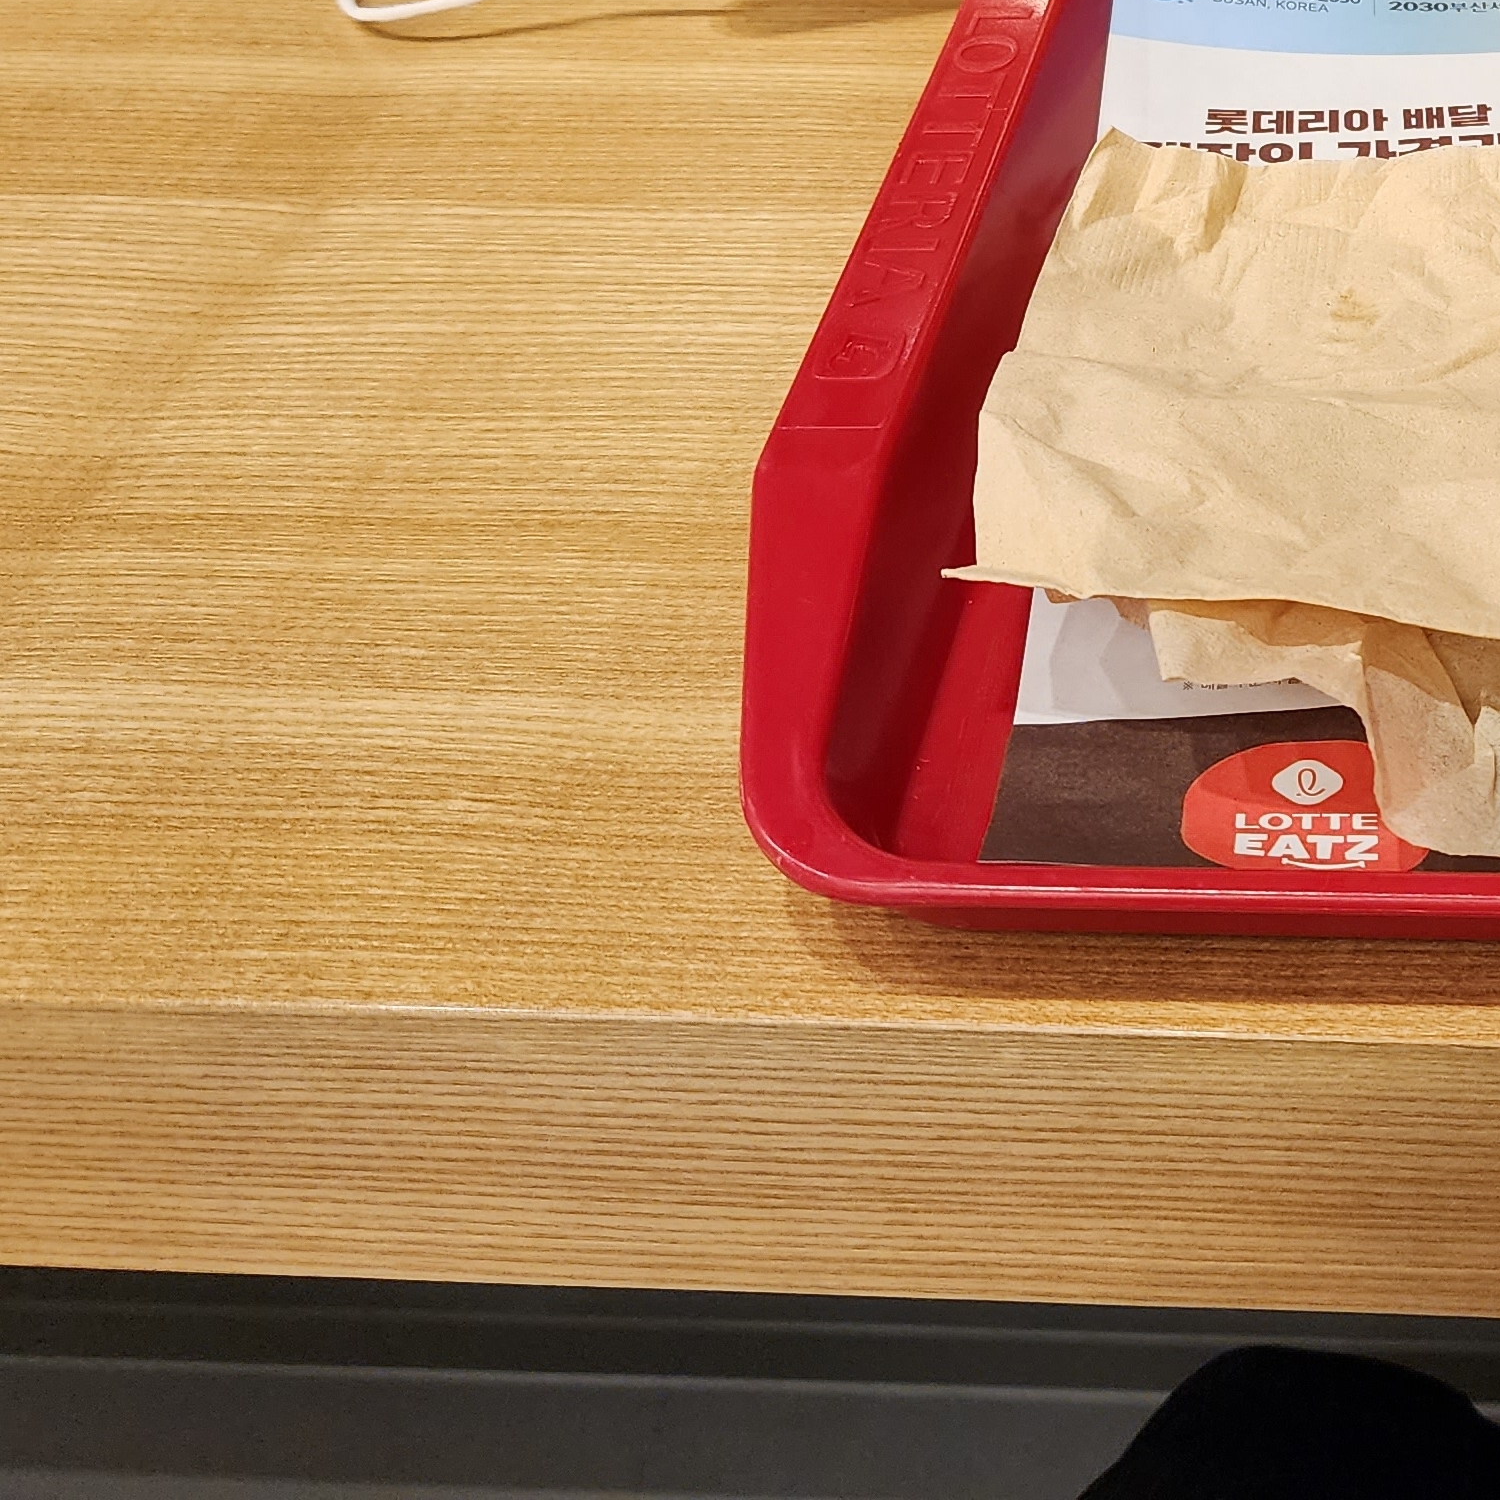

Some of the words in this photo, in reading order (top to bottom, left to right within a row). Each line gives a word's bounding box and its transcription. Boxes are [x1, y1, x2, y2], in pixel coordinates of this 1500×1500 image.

[1275, 0, 1330, 13] KOREA
[1204, 108, 1389, 135] 롯데리아
[1402, 103, 1493, 130] 배달
[1234, 812, 1379, 831] LOTTE
[1233, 832, 1379, 862] EATZ
